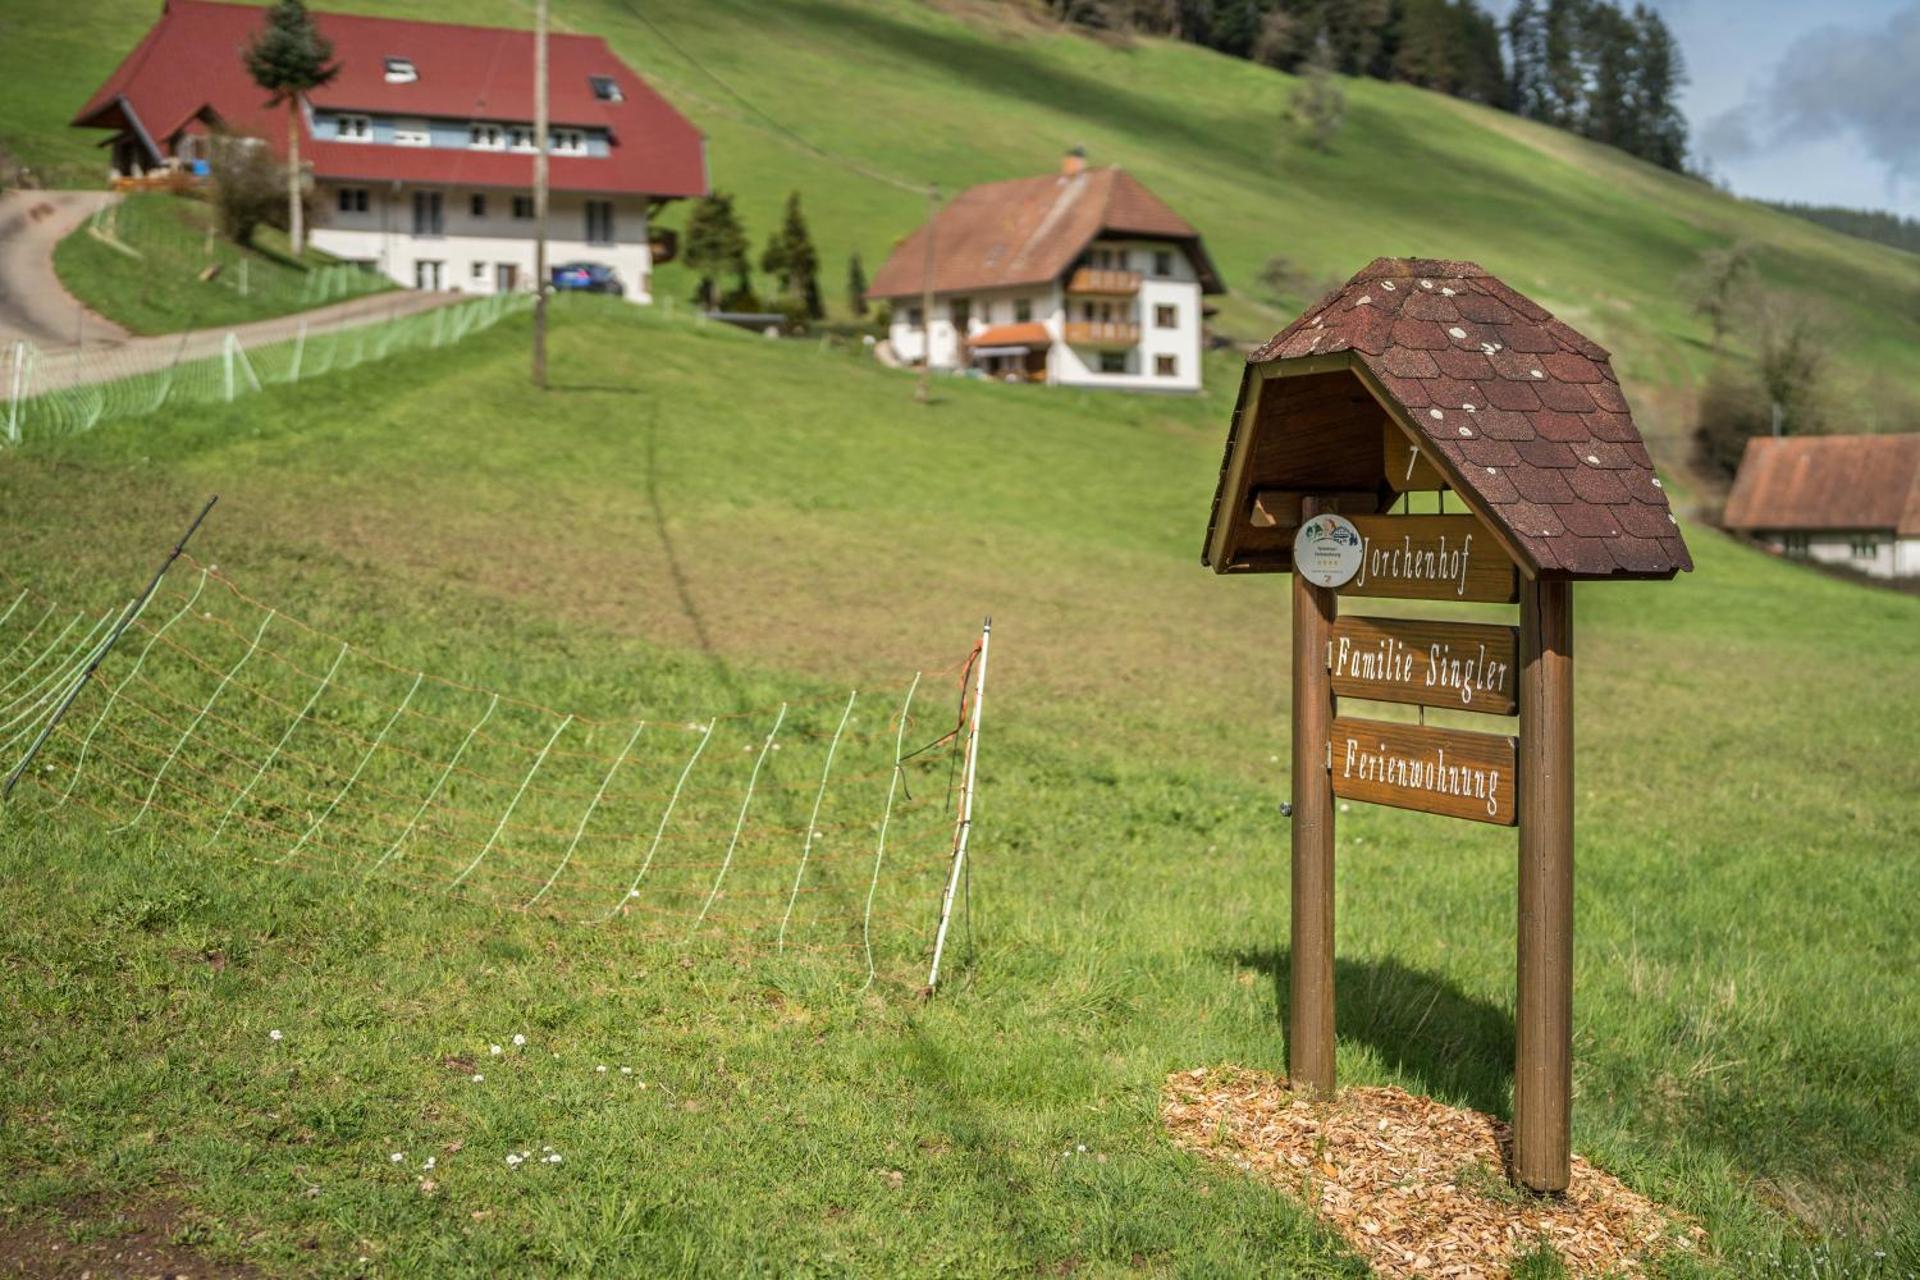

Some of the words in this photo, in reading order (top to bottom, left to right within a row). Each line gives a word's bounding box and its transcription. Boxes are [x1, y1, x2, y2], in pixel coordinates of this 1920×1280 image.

[1357, 534, 1472, 595] Jorchenhof
[1335, 637, 1412, 682] Familie
[1426, 643, 1507, 703] Singler
[1343, 739, 1498, 816] Ferienwohnung
